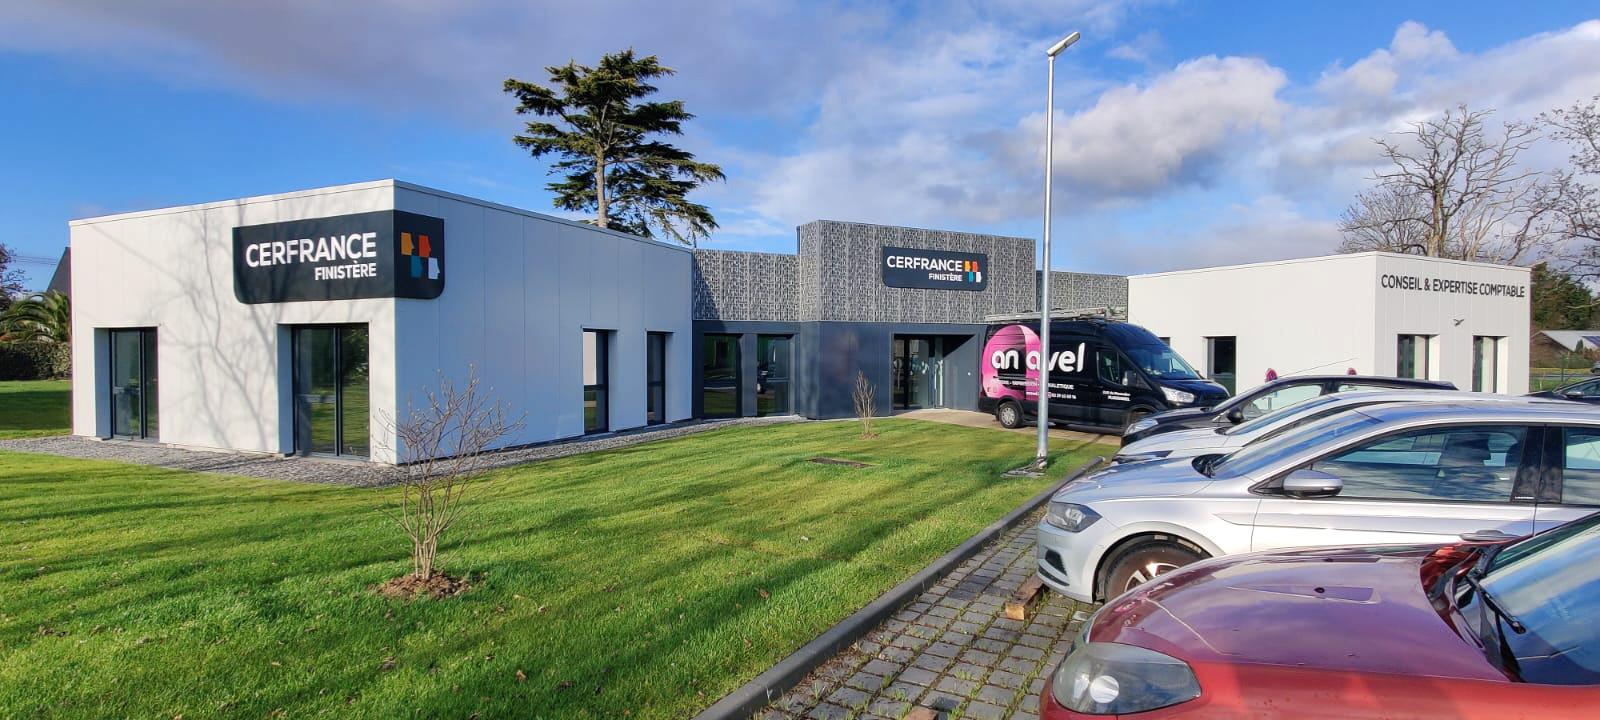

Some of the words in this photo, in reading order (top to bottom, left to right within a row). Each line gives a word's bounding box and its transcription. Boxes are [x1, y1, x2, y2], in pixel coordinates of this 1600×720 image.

[245, 232, 377, 268] CERFRANCE
[314, 260, 377, 281] FINISTÈRE
[886, 255, 963, 272] CERFRANCE
[928, 272, 963, 282] FINISTÈRE
[1381, 274, 1422, 291] CONSEIL
[1423, 278, 1431, 291] &
[1432, 278, 1478, 295] EXPERTISE
[1479, 283, 1525, 298] COMPTABLE
[991, 349, 1019, 370] an
